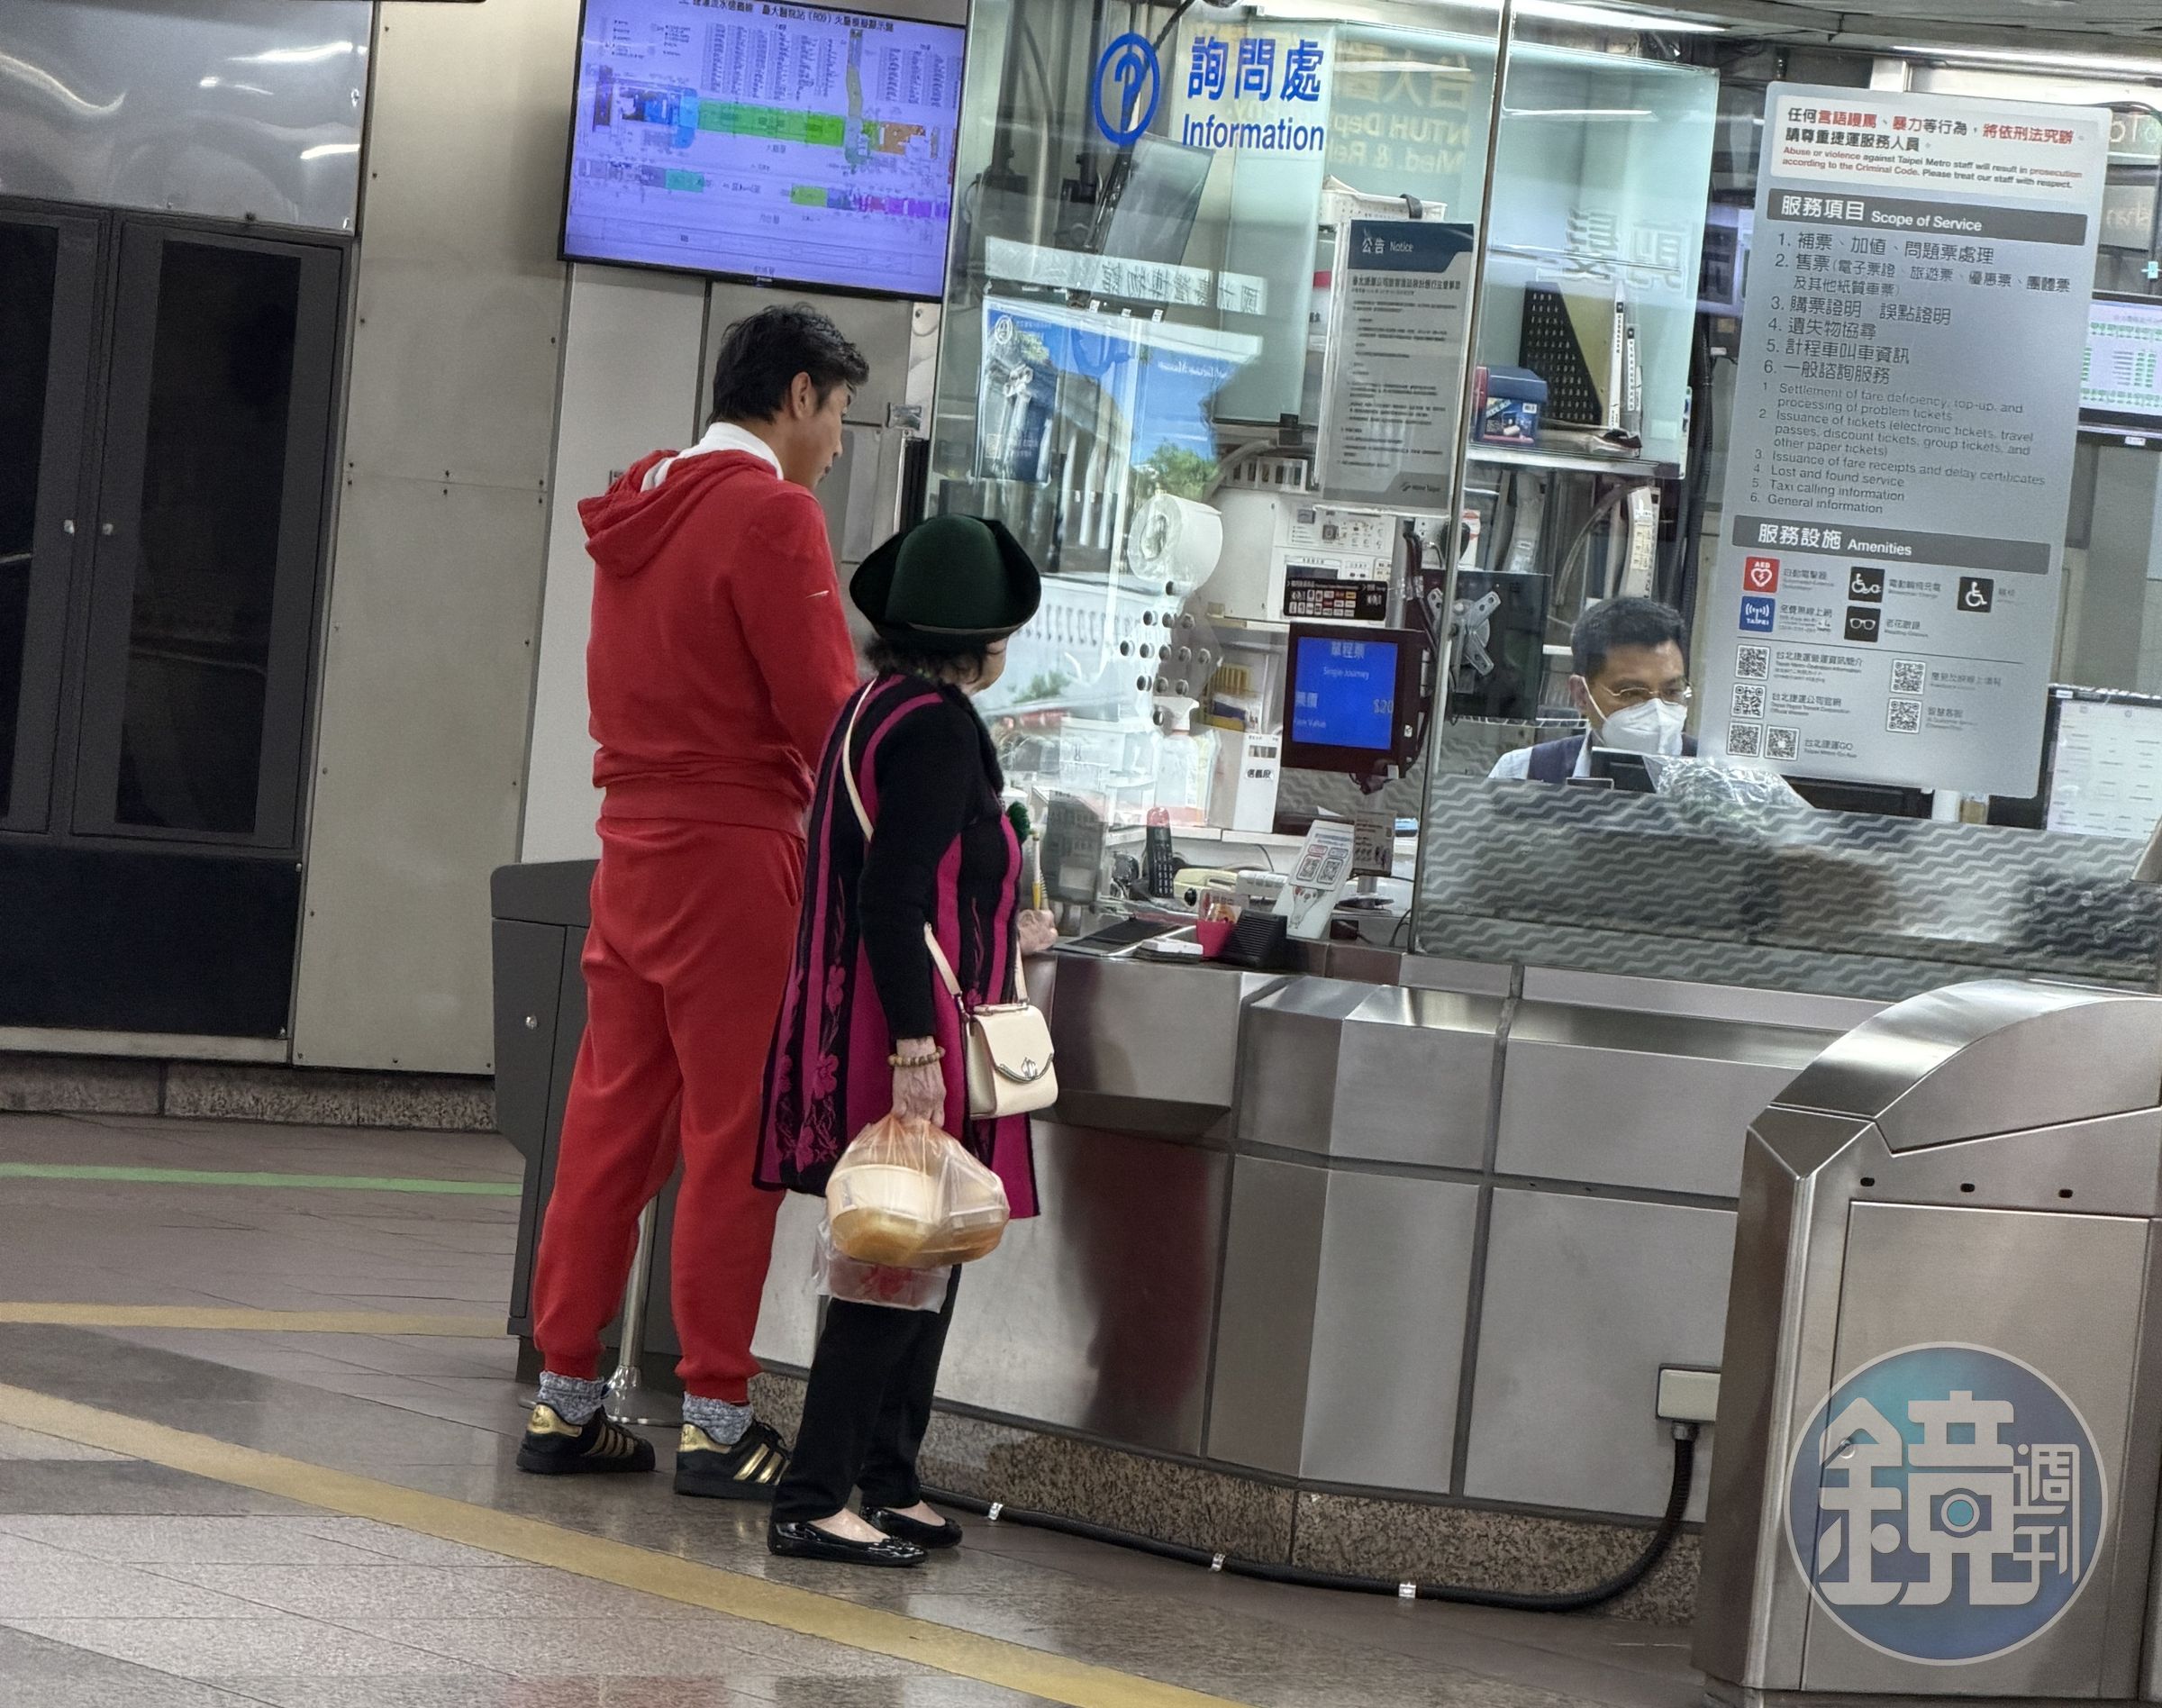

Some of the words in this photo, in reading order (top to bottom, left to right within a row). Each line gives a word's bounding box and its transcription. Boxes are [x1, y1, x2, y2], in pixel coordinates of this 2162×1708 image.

[1187, 36, 1324, 102] 詢問處
[1182, 114, 1324, 151] Information
[1783, 146, 1811, 156] Abuse
[1825, 149, 1860, 160] violence
[1863, 152, 1895, 163] against
[1897, 155, 1923, 166] Taipei
[1925, 157, 1951, 168] Metro
[1953, 161, 1974, 169] staff
[1976, 163, 1990, 171] will
[1992, 165, 2017, 174] result
[2019, 166, 2028, 174] in
[2030, 168, 2083, 178] prosecution
[1783, 158, 1826, 169] according
[1829, 160, 1837, 169] to
[1840, 161, 1853, 170] the
[1856, 163, 1892, 174] Criminal
[1894, 167, 1921, 176] Code.
[1922, 168, 1951, 178] Please
[1954, 171, 1975, 180] treat
[1977, 174, 1992, 182] our
[1994, 175, 2013, 184] staff
[2015, 176, 2035, 186] with
[2037, 178, 2073, 189] respect.
[1781, 195, 1865, 222] 服務項目
[1871, 210, 1913, 226] Scope
[1916, 214, 1930, 227] of
[1933, 215, 1983, 232] Service
[1361, 237, 1385, 255] 公告
[1389, 241, 1414, 253] Notice
[1778, 232, 1791, 247] 1.
[1775, 253, 1789, 268] 2.
[1771, 295, 1785, 311] 3.
[1768, 317, 1782, 332] 4.
[1787, 316, 1877, 341] 遺失物協尋
[1766, 339, 1779, 353] 5.
[1785, 338, 1910, 364] 計程車叫車資訊
[1764, 359, 1777, 374] 6.
[1783, 360, 1890, 385] 一般諮詢服務
[1777, 397, 1842, 413] processing
[1847, 404, 1858, 413] of
[1860, 405, 1910, 418] problem
[1913, 408, 1953, 422] tickets
[1779, 383, 1842, 398] Settlement
[1846, 388, 1858, 399] of
[1861, 389, 1884, 402] fare
[2000, 404, 2023, 413] and
[1776, 409, 1829, 424] Issuance
[1831, 415, 1844, 425] of
[1848, 417, 1886, 430] tickets
[1889, 420, 1950, 435] (electronic
[2001, 430, 2034, 441] travel
[1774, 438, 1804, 450] other
[1807, 441, 1842, 453] paper
[1846, 442, 1889, 457] tickets)
[1823, 428, 1875, 441] discount
[1922, 438, 1958, 450] group
[2007, 444, 2031, 456] and
[1771, 465, 1796, 477] Lost
[1799, 468, 1822, 479] and
[1825, 470, 1859, 483] found
[1862, 474, 1905, 487] service
[1772, 451, 1825, 466] Issuance
[1828, 456, 1840, 467] of
[1843, 459, 1866, 469] fare
[1868, 460, 1916, 475] receipts
[1919, 465, 1942, 476] and
[1944, 468, 1976, 481] delay
[1979, 471, 2046, 486] certificates
[1769, 479, 1794, 492] Taxi
[1796, 482, 1836, 497] calling
[1839, 486, 1905, 502] information
[1767, 494, 1813, 508] General
[1816, 498, 1884, 514] information
[1758, 522, 1843, 550] 服務設施
[1847, 539, 1912, 557] Amenities
[1754, 561, 1771, 569] AED
